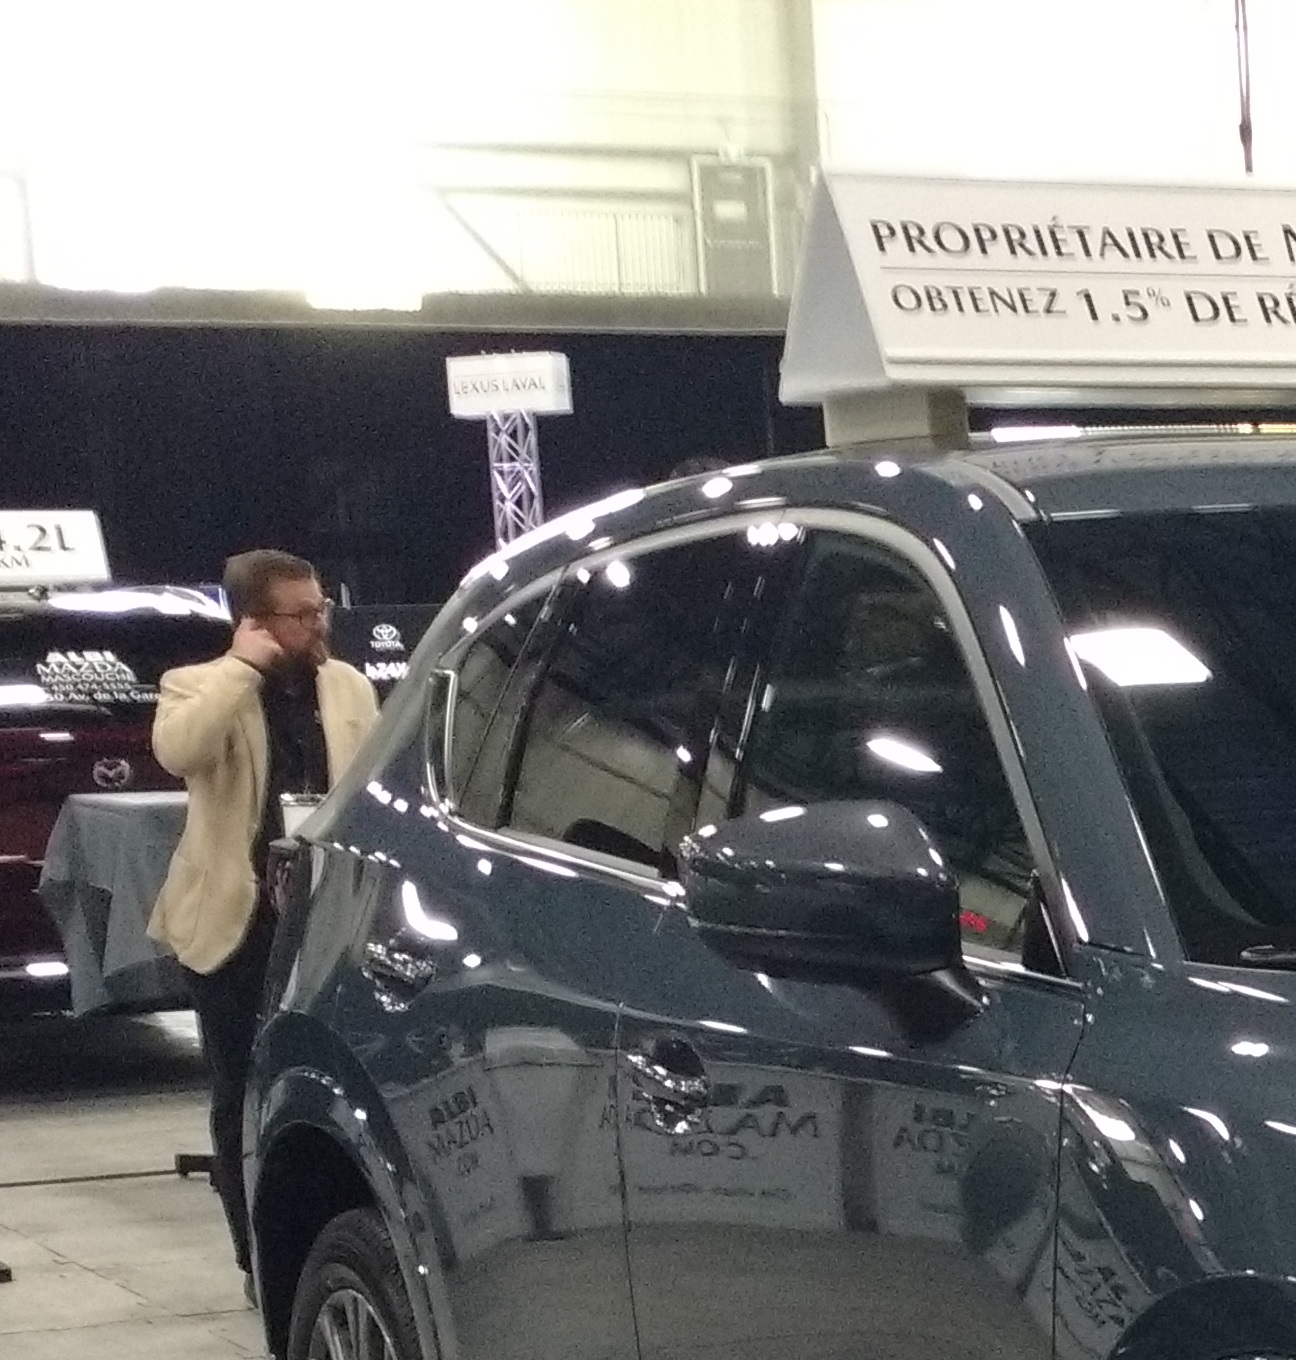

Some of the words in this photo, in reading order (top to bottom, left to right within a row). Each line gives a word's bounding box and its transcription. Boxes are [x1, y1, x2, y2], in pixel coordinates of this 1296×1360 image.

[870, 215, 1198, 260] PROPRIÉTAIRE
[1206, 228, 1270, 261] DE
[891, 284, 1067, 315] OBTENEZ
[1076, 287, 1171, 322] 1.5%
[1184, 290, 1248, 323] DE
[453, 379, 499, 395] LEXUS
[502, 376, 545, 392] LAVAL
[370, 640, 404, 650] TOYOTA
[36, 662, 133, 674] MAZDA
